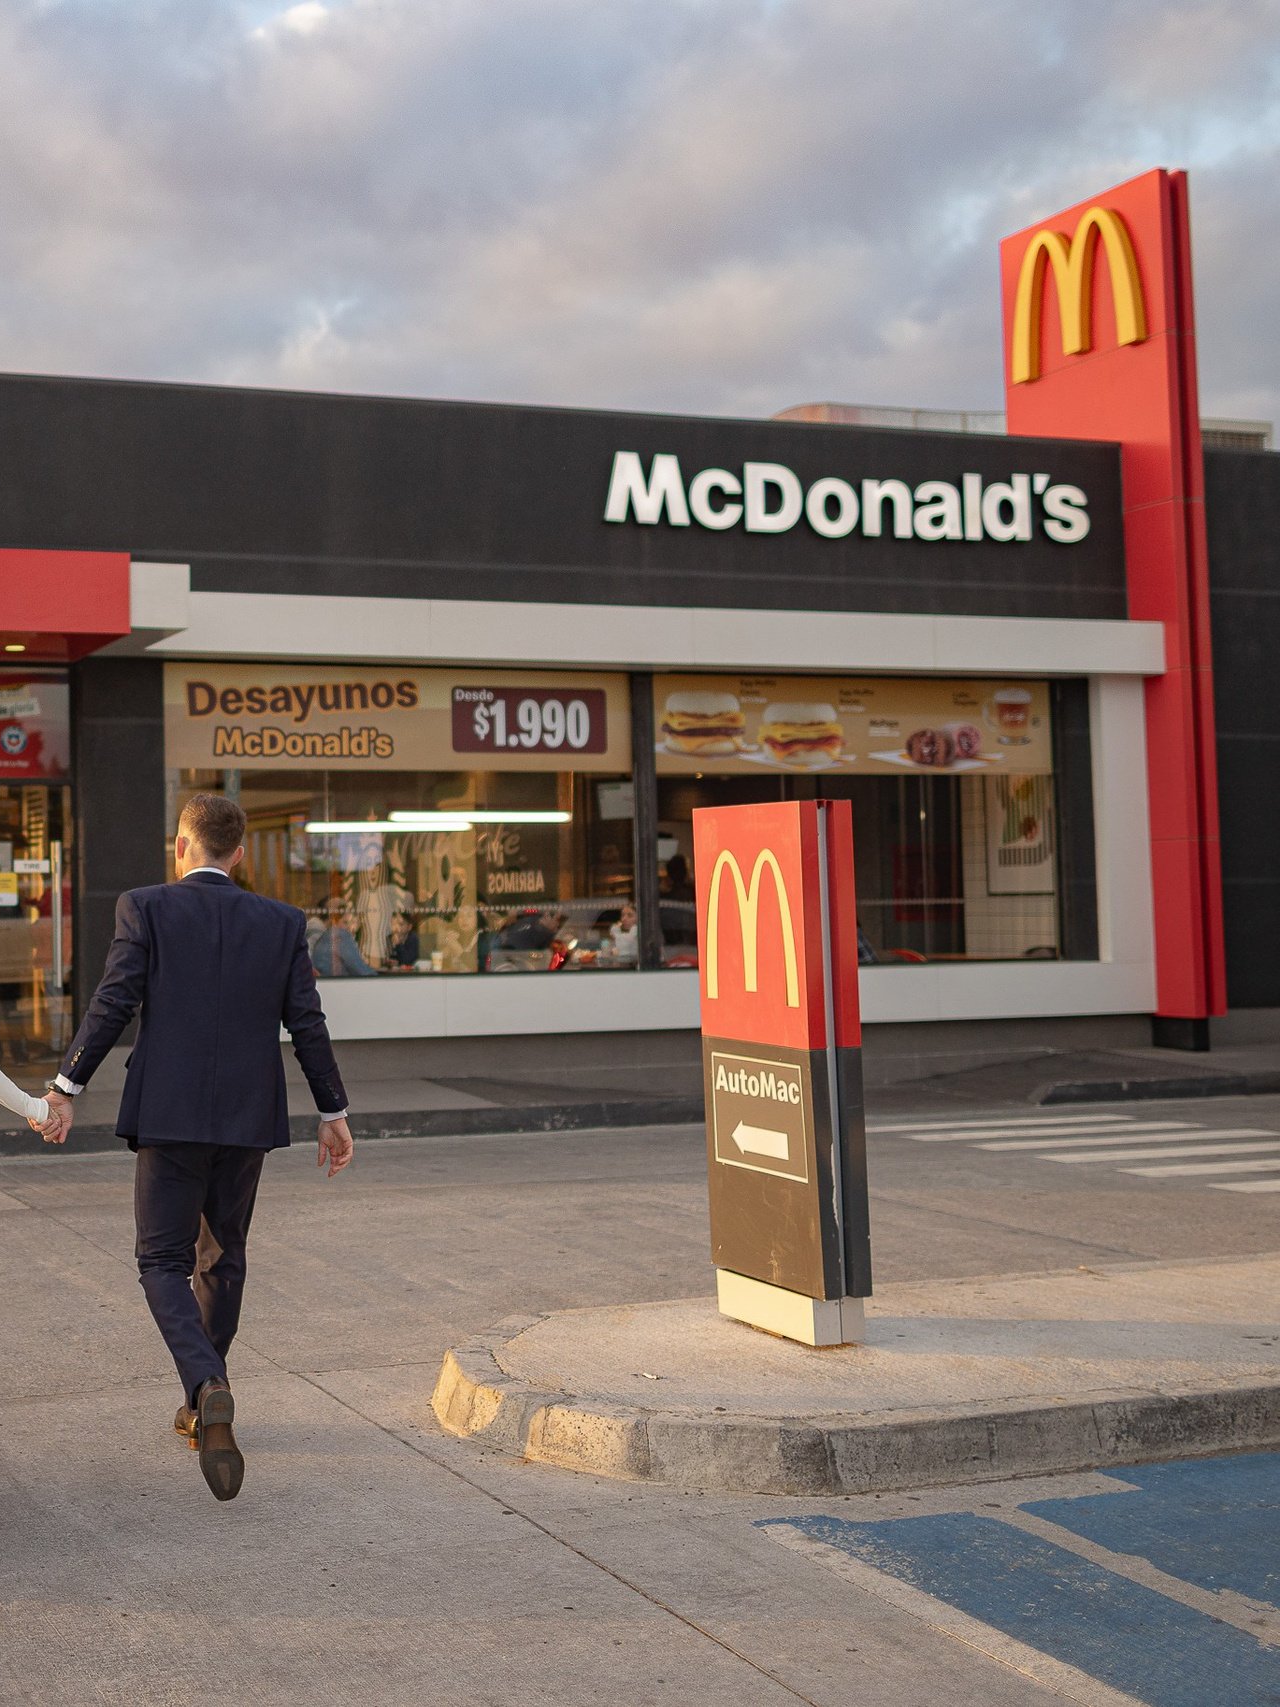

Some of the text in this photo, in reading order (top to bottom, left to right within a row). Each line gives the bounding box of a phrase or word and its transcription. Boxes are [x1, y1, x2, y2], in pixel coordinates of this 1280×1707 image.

[604, 451, 1091, 543] McDonald's
[185, 680, 420, 724] Desayunos
[455, 688, 494, 701] Desde
[213, 726, 395, 759] McDonald's
[473, 698, 590, 749] $1.990
[715, 1064, 800, 1105] AutoMac
